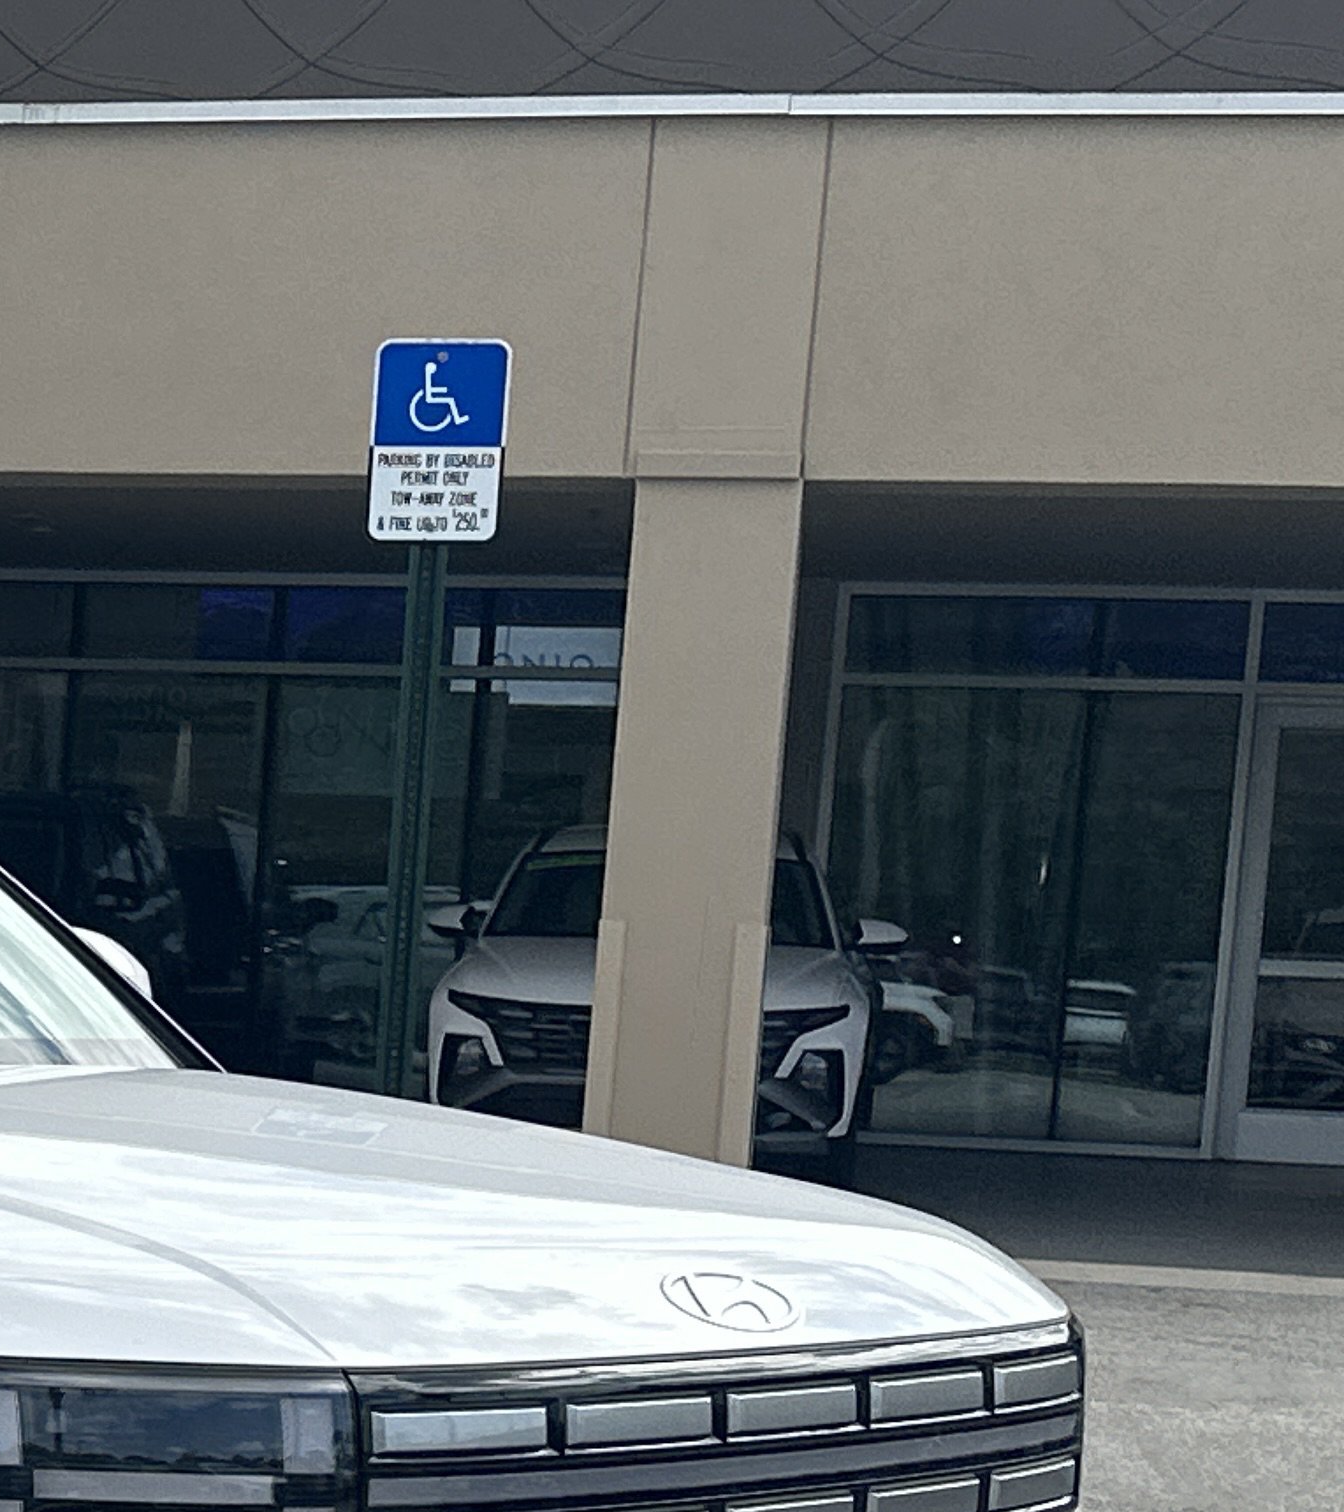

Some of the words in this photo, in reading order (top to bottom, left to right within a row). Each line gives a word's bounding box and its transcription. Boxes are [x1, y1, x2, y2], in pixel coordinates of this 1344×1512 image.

[377, 453, 422, 468] PARKING
[425, 454, 440, 468] BY
[444, 453, 495, 469] DISABLED
[400, 471, 439, 486] PERMIT
[442, 471, 469, 486] ONLY
[390, 491, 444, 506] TOW-AWAY
[448, 491, 478, 506] ZONE
[389, 516, 412, 531] FINE
